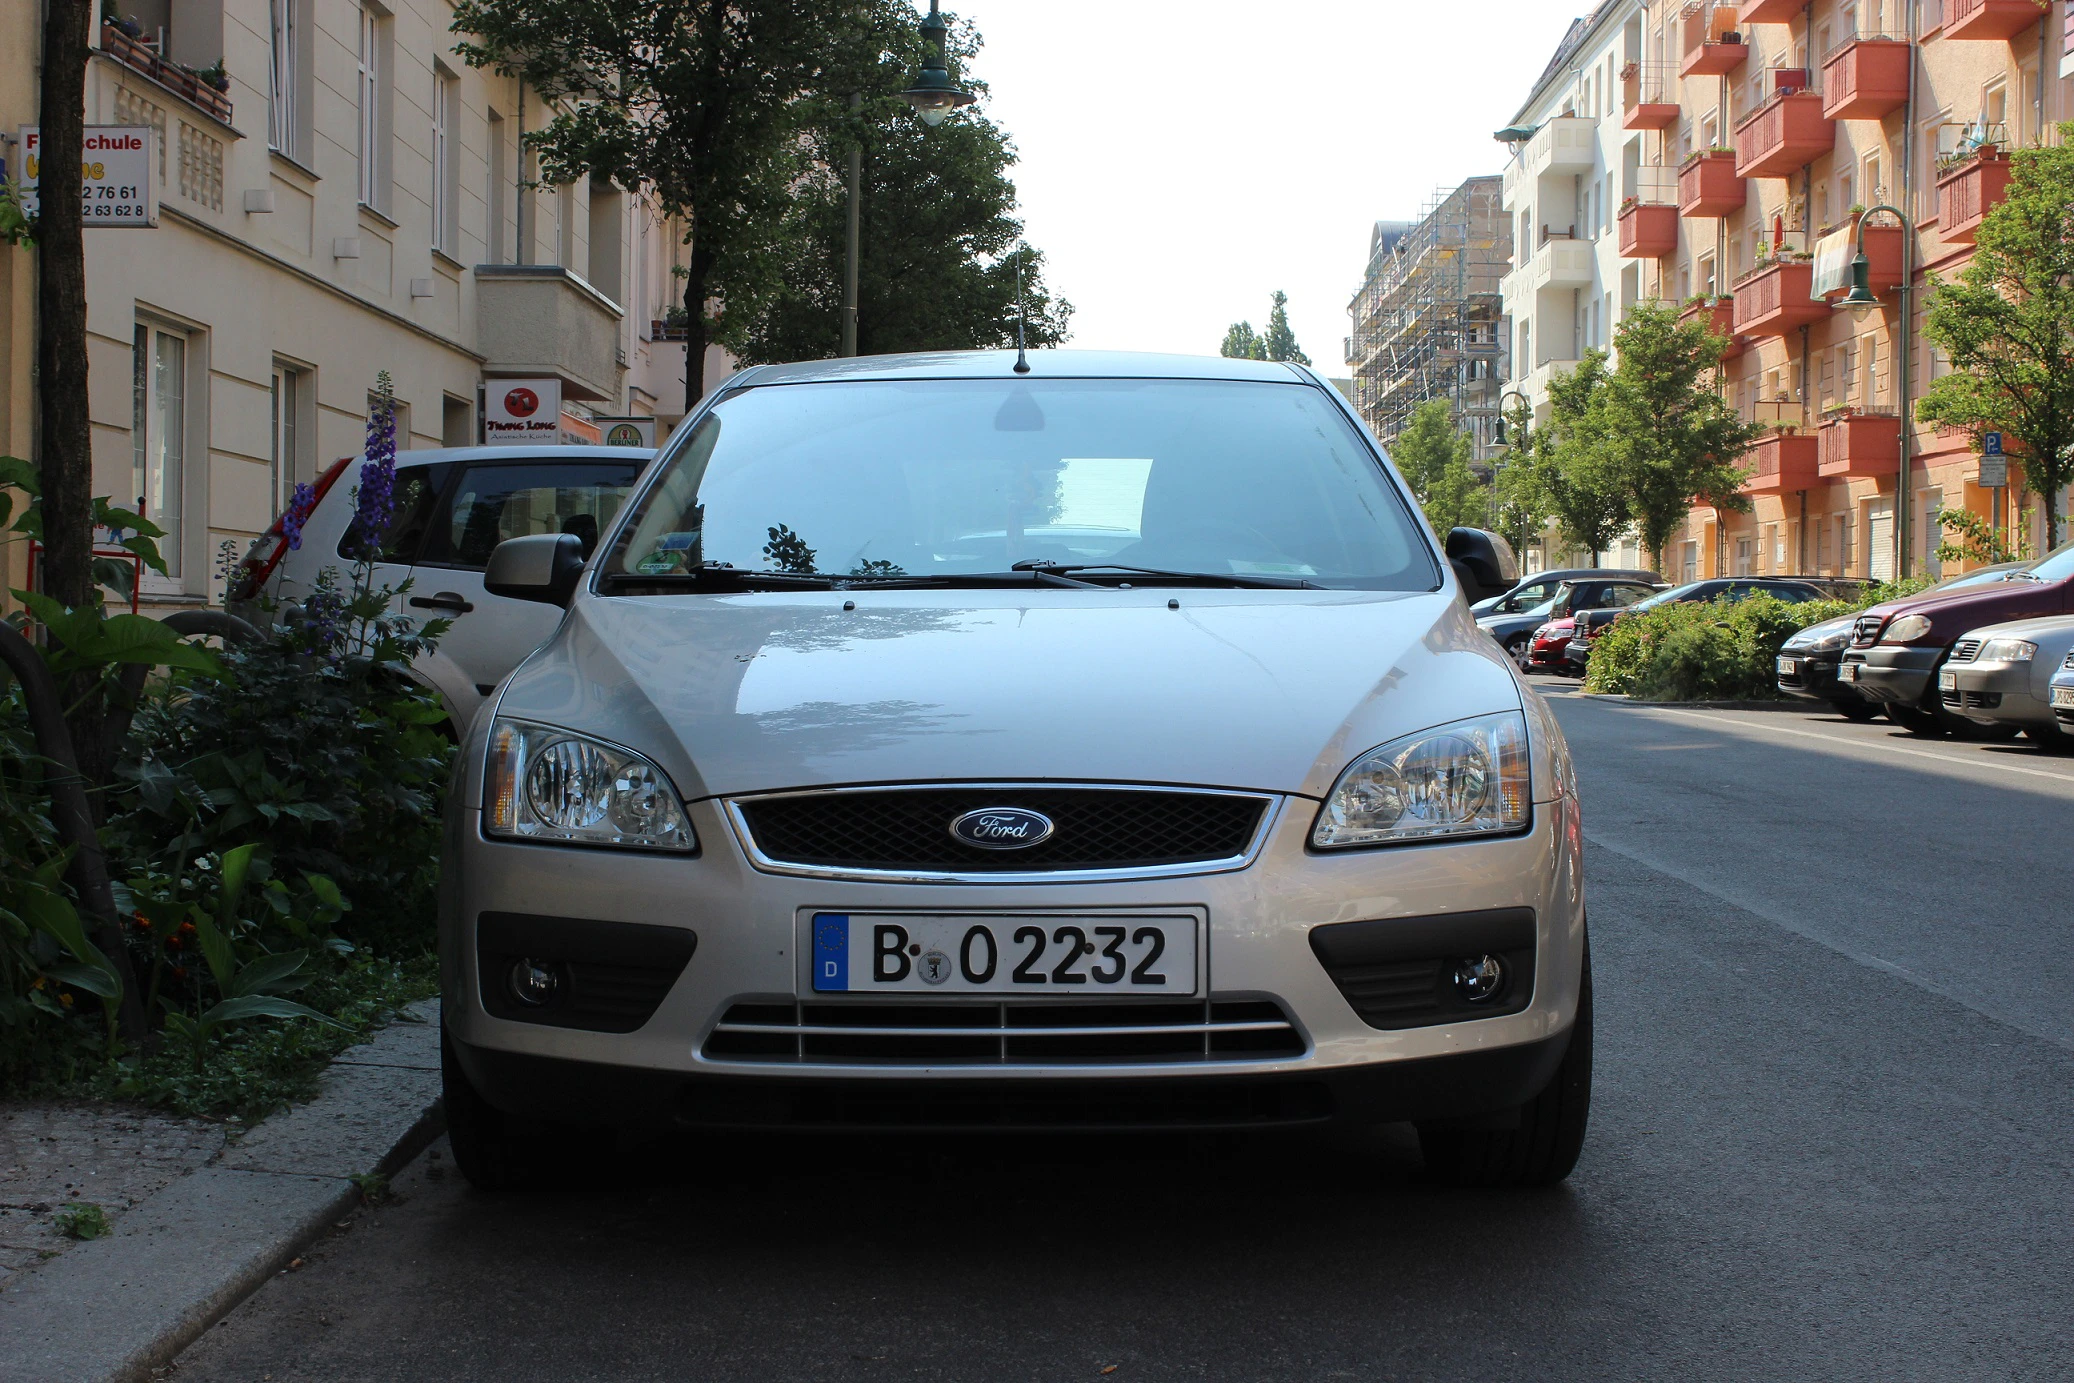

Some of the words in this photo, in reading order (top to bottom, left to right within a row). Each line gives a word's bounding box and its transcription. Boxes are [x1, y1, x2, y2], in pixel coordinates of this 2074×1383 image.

[27, 134, 142, 150] Fchule
[97, 186, 115, 199] 76
[120, 186, 137, 199] 61
[95, 205, 111, 216] 63
[115, 205, 131, 216] 62
[135, 205, 143, 216] 8
[1987, 435, 1997, 453] P
[973, 815, 1029, 838] Ford
[873, 924, 911, 982] B
[1012, 925, 1166, 985] 2232
[825, 961, 838, 978] D
